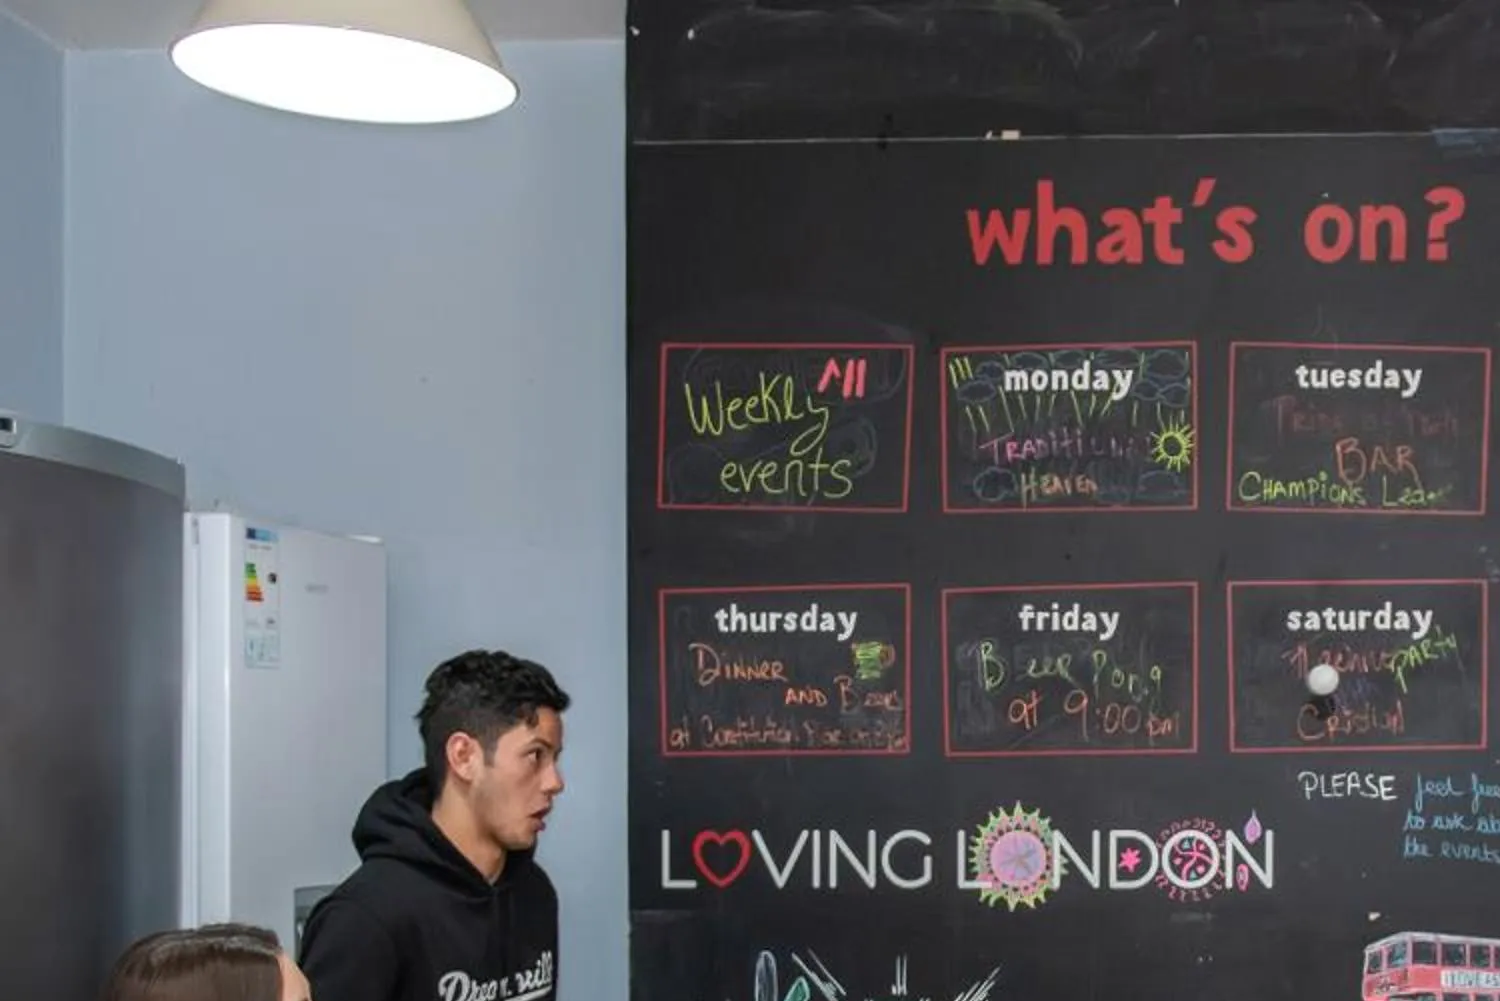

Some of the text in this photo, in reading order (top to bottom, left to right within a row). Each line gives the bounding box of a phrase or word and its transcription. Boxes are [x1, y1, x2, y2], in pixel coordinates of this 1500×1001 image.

[967, 177, 1466, 265] what's on?
[1004, 359, 1134, 401] monday
[1295, 359, 1423, 399] tuesday
[720, 447, 855, 499] events
[714, 603, 858, 642] thursday
[1018, 602, 1121, 641] friday
[1286, 601, 1434, 641] saturday
[785, 686, 829, 708] AND
[1298, 770, 1398, 800] PLEASE
